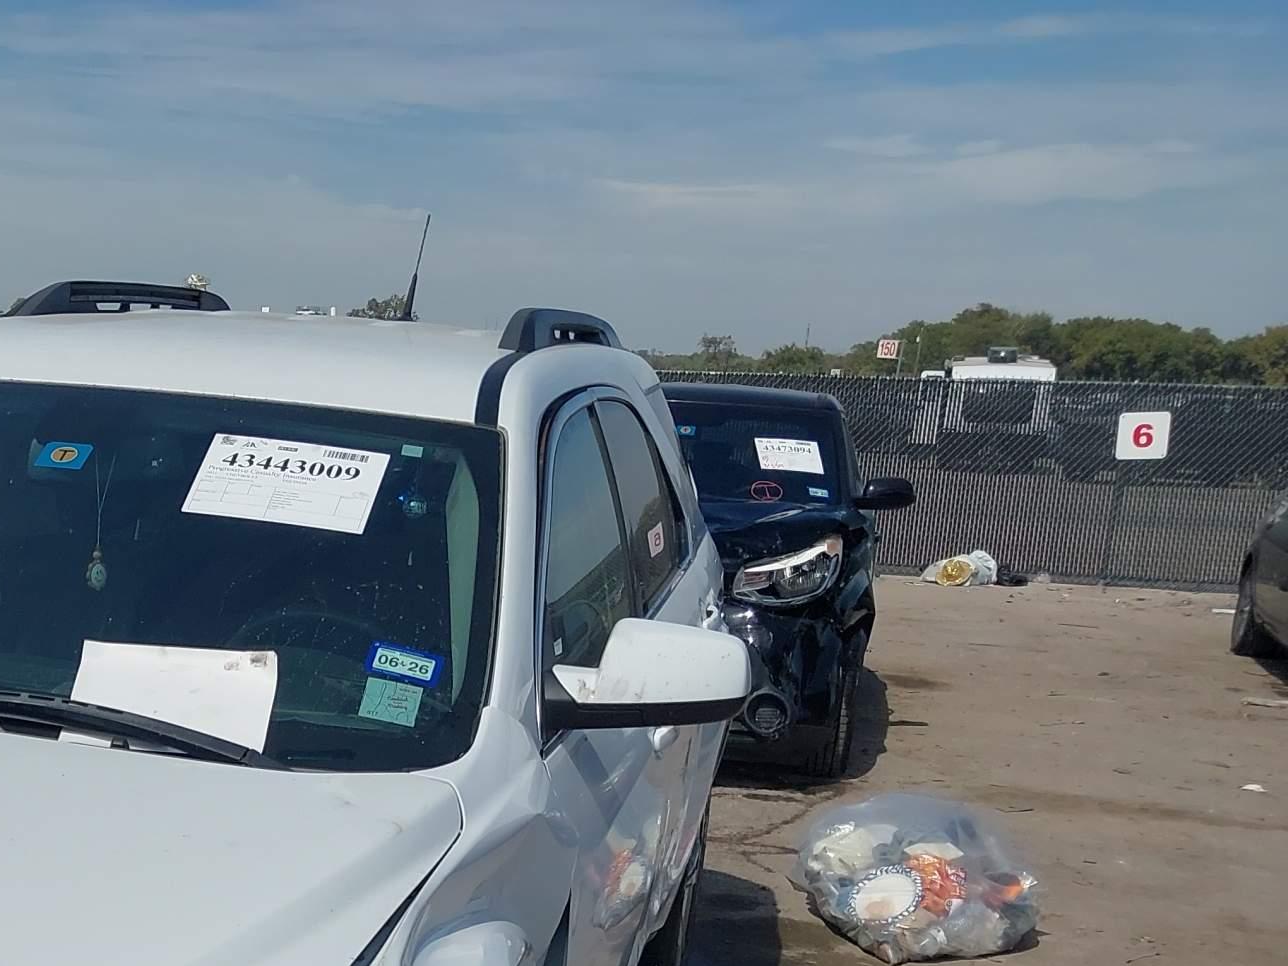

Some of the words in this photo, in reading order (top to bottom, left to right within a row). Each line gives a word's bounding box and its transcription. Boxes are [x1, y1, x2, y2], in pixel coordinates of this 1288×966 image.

[880, 342, 896, 356] 150
[1132, 423, 1154, 448] 6
[58, 449, 75, 461] T
[221, 452, 361, 481] 43443009
